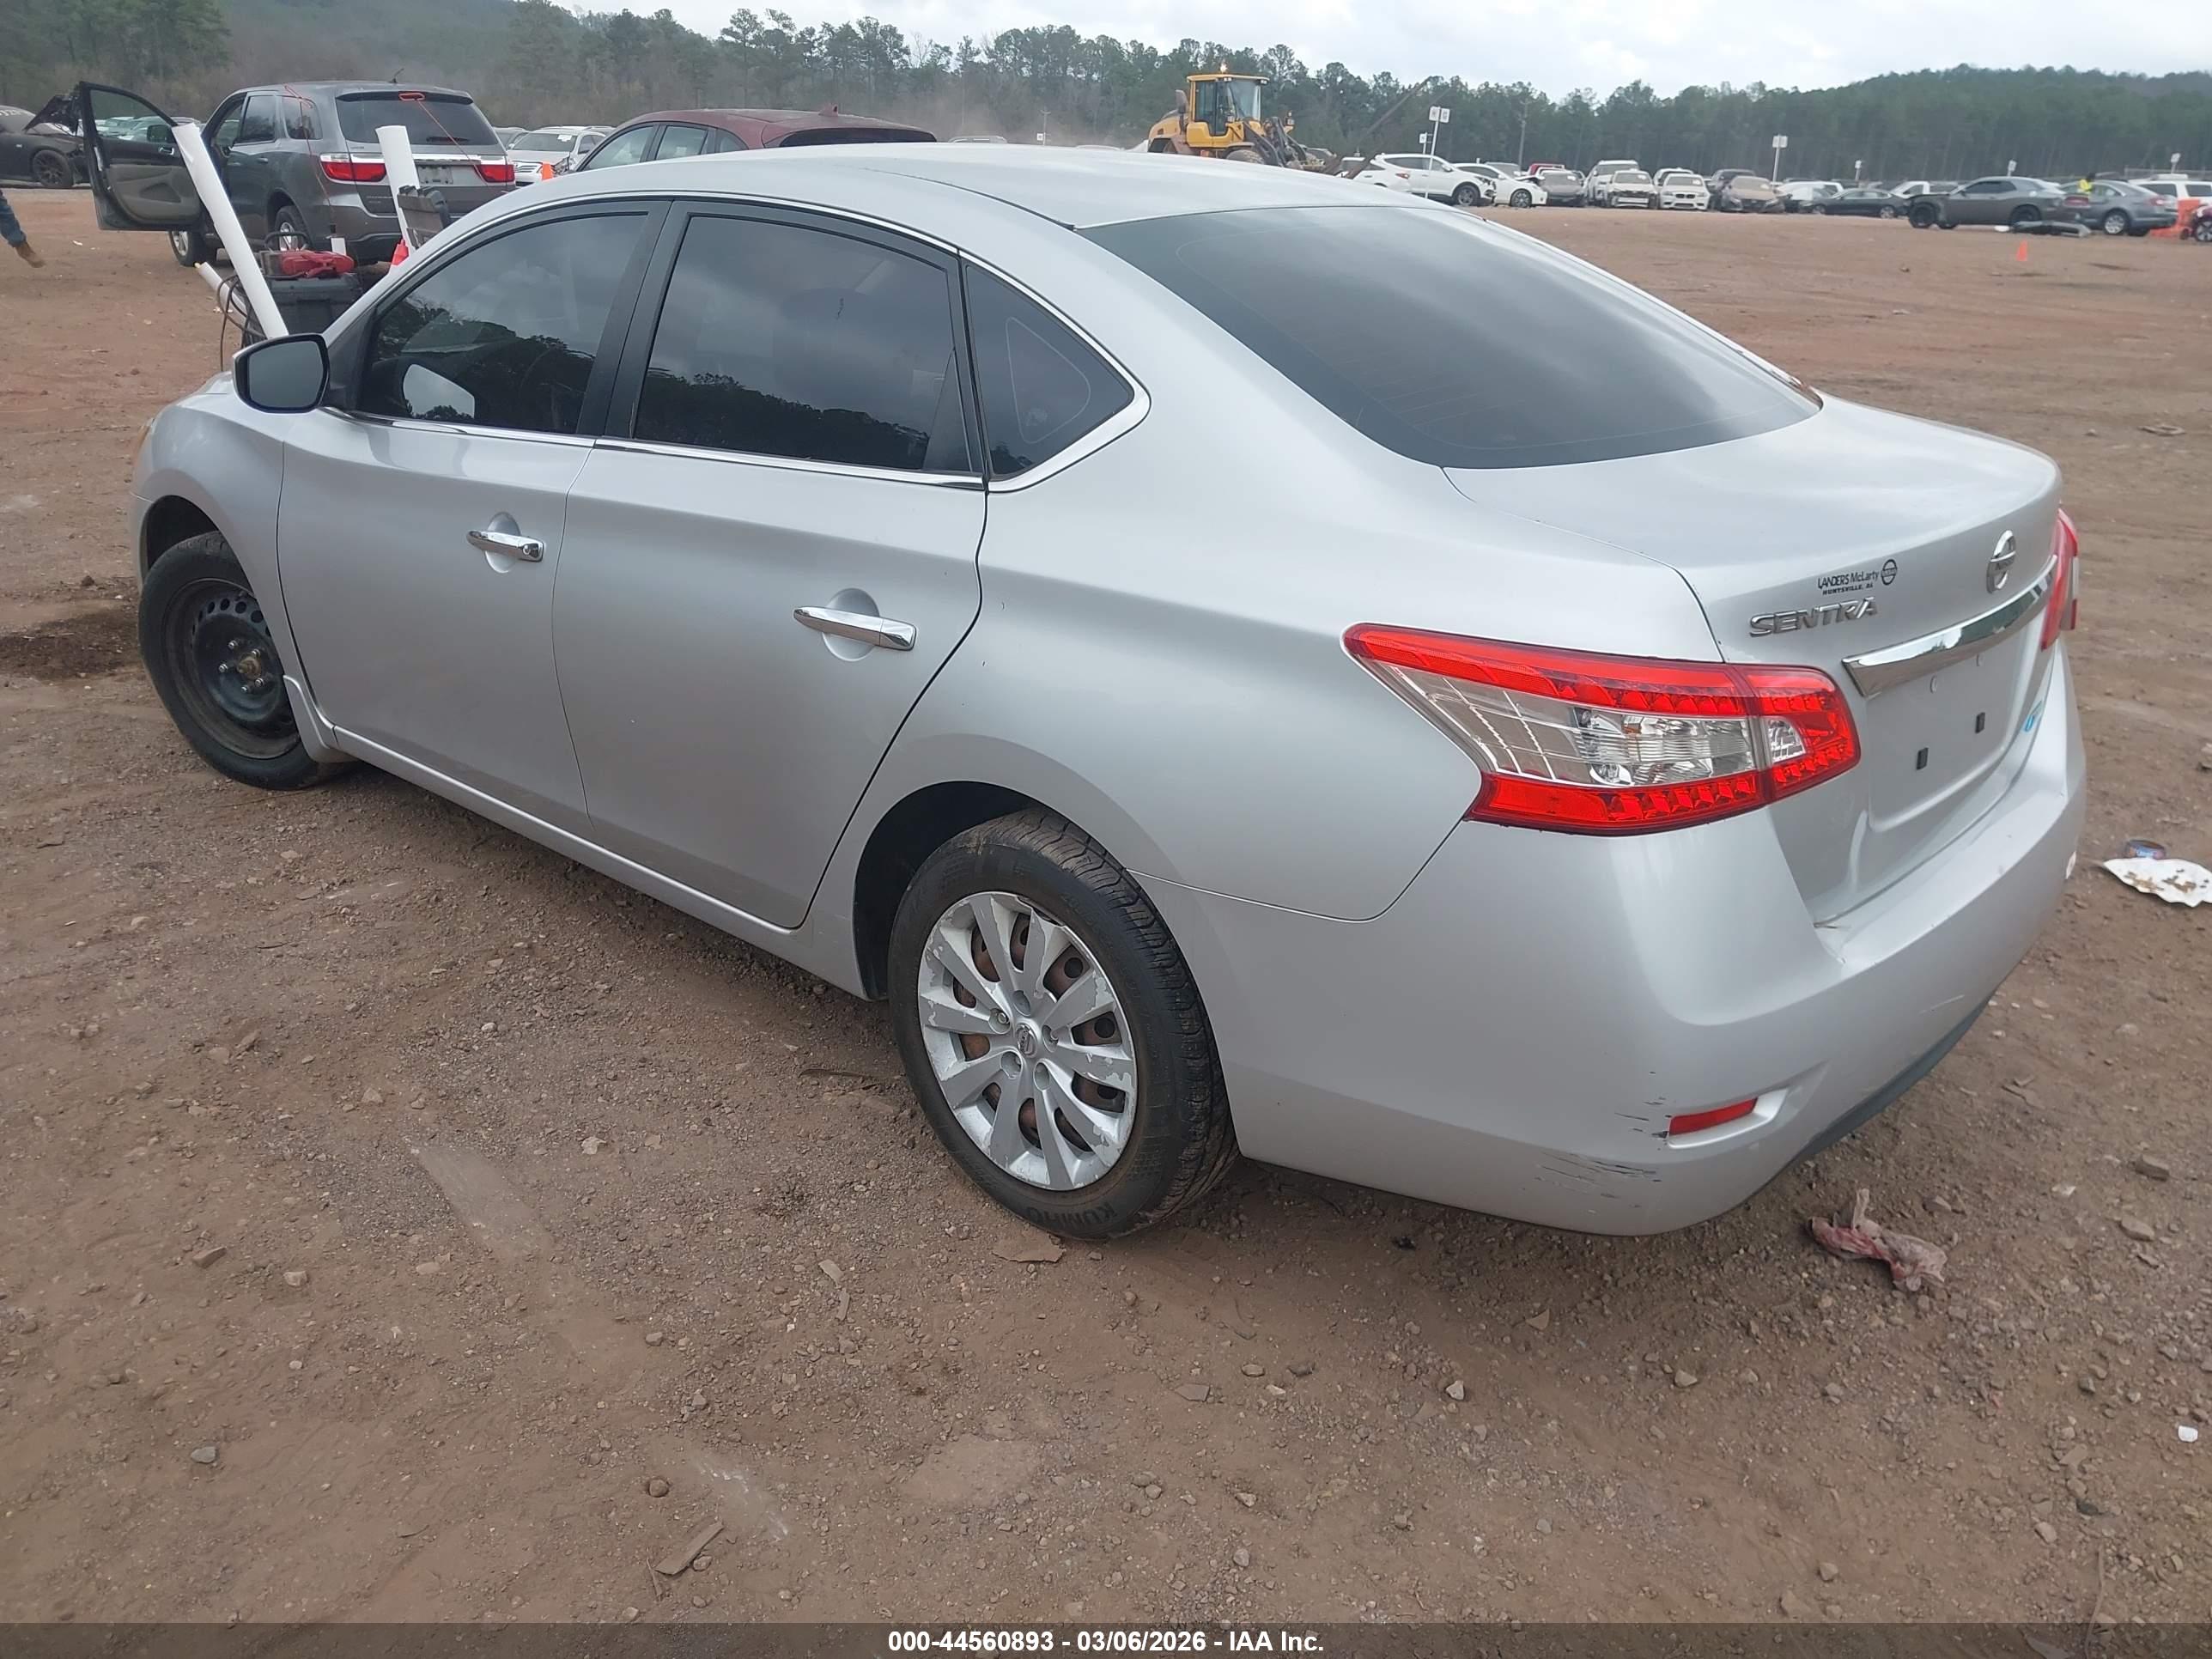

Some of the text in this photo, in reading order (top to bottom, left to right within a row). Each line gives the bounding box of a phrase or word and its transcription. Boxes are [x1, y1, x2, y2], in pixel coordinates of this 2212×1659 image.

[1817, 573, 1850, 590] LANDERS
[1850, 570, 1880, 583] McLarty
[1749, 596, 1878, 637] SENTRA
[1026, 1202, 1118, 1225] KUMHO
